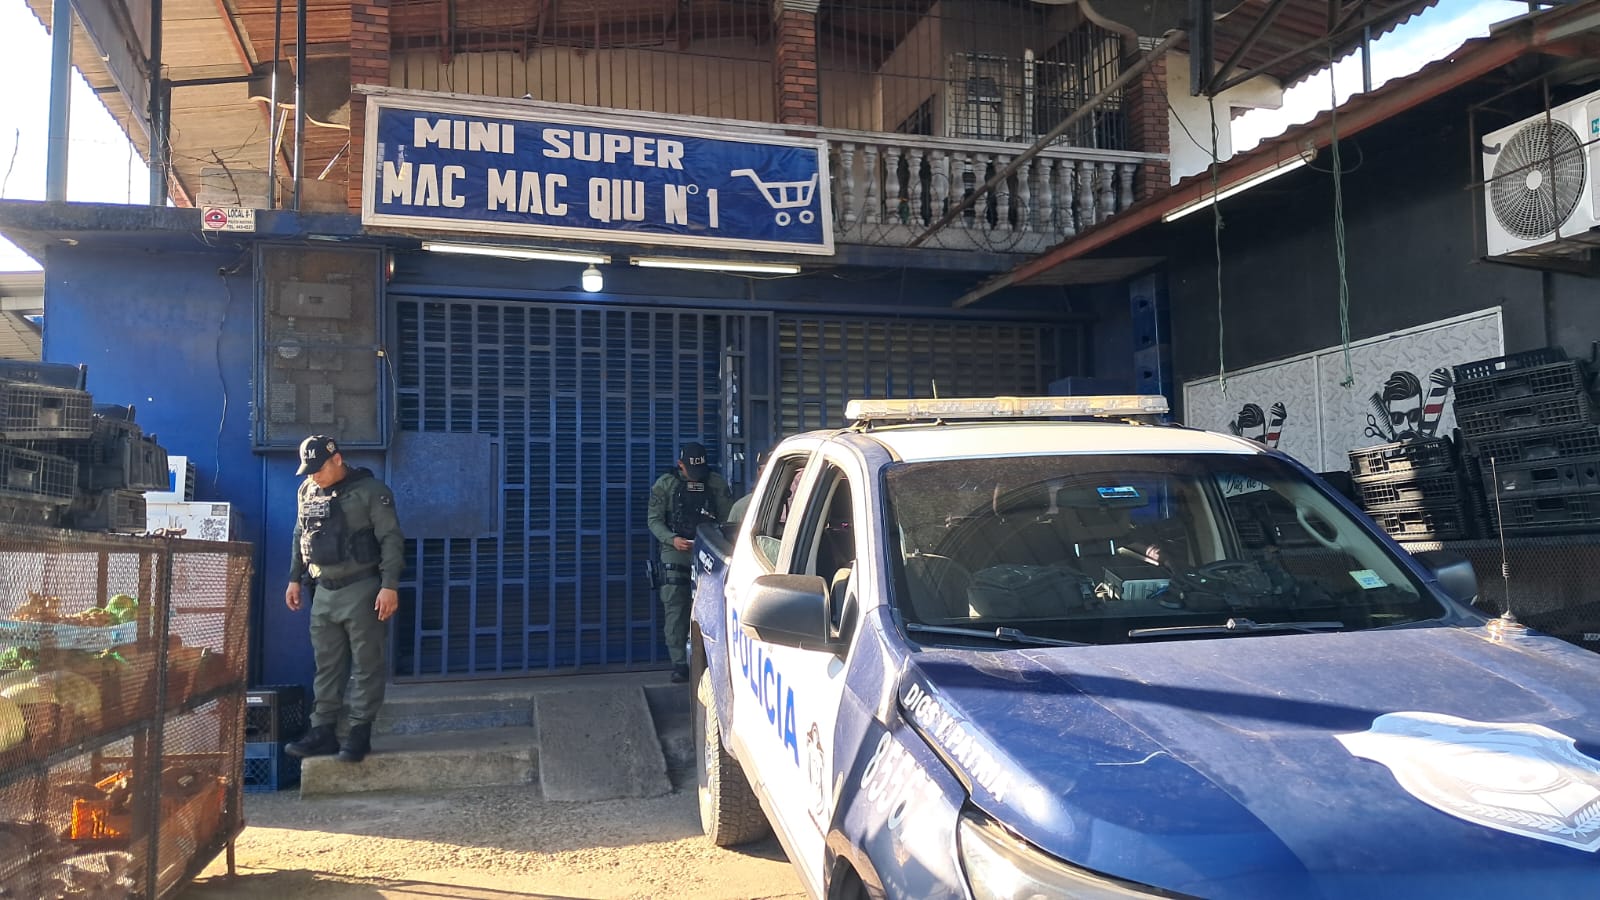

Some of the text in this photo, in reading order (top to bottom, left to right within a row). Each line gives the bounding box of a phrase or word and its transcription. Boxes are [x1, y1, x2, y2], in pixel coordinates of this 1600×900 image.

[413, 117, 685, 170] MINI SUPER
[227, 208, 244, 218] LOCAL
[382, 161, 466, 208] MAC
[487, 168, 568, 217] MAC
[588, 177, 645, 222] QIU
[706, 188, 719, 228] 1
[731, 607, 800, 769] POLICIA
[903, 682, 941, 726] DIOS
